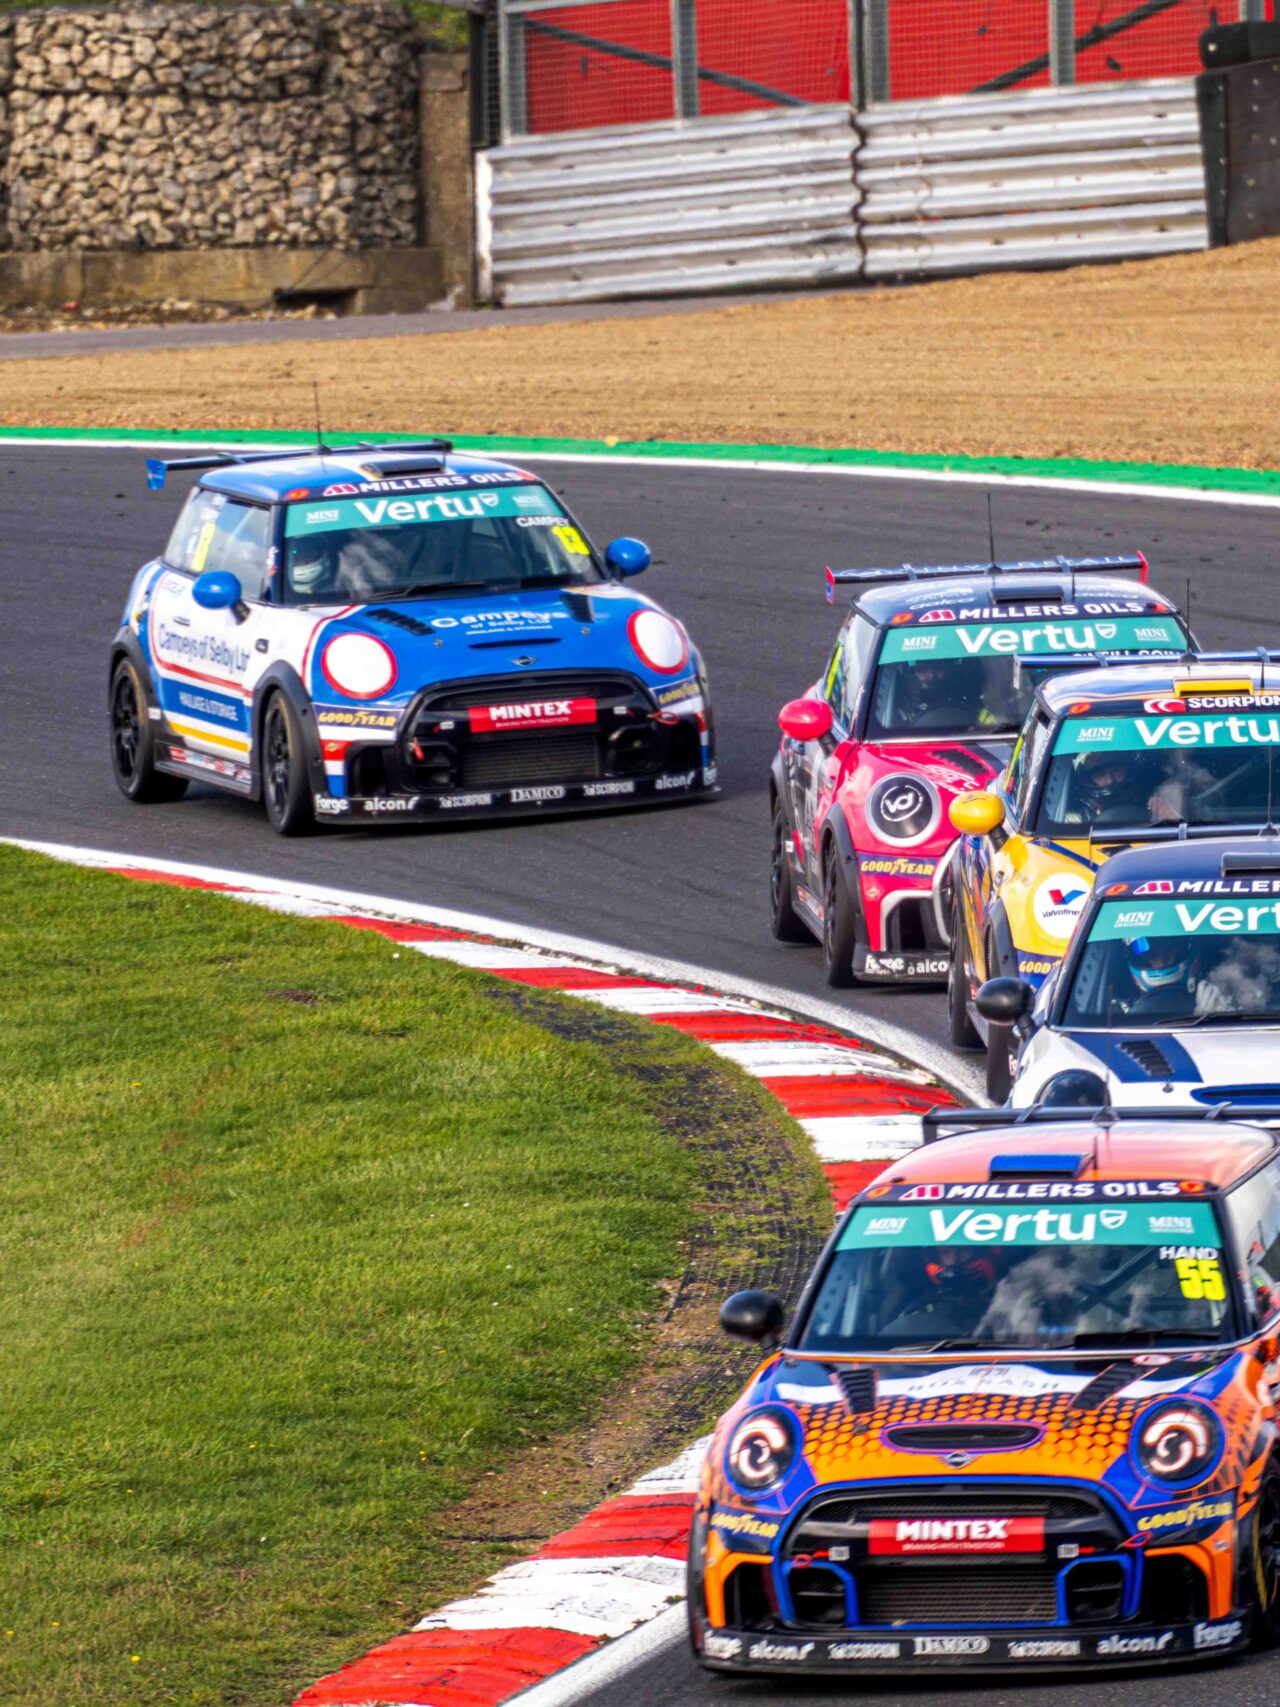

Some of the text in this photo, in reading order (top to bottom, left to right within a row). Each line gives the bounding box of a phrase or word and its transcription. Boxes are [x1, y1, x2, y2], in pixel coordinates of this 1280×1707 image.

[359, 471, 523, 493] MILLERS OILS
[355, 493, 482, 524] Vertu
[516, 516, 569, 528] CAMPEY
[431, 611, 569, 628] Campeys
[959, 602, 1144, 620] MILLERS OILS
[902, 636, 937, 647] MINI
[955, 624, 1096, 654] Vertu
[1134, 628, 1167, 637] MINI
[319, 710, 396, 728] GOODYEAR
[488, 700, 573, 721] MINTEX
[1079, 727, 1114, 737] MINI
[655, 774, 688, 790] alcon
[364, 797, 407, 811] alcon
[861, 858, 934, 876] GOODYEAR
[1118, 911, 1154, 922] MINI
[944, 1181, 1181, 1199] MILLERS OILS
[929, 1209, 1097, 1242] Vertu
[1159, 1245, 1219, 1261] HAND
[1174, 1256, 1227, 1301] 55
[1137, 1501, 1233, 1531] GOODYEAR
[711, 1512, 779, 1539] GOODYEAR
[896, 1519, 1009, 1541] MINTEX
[1096, 1635, 1159, 1655] alcon
